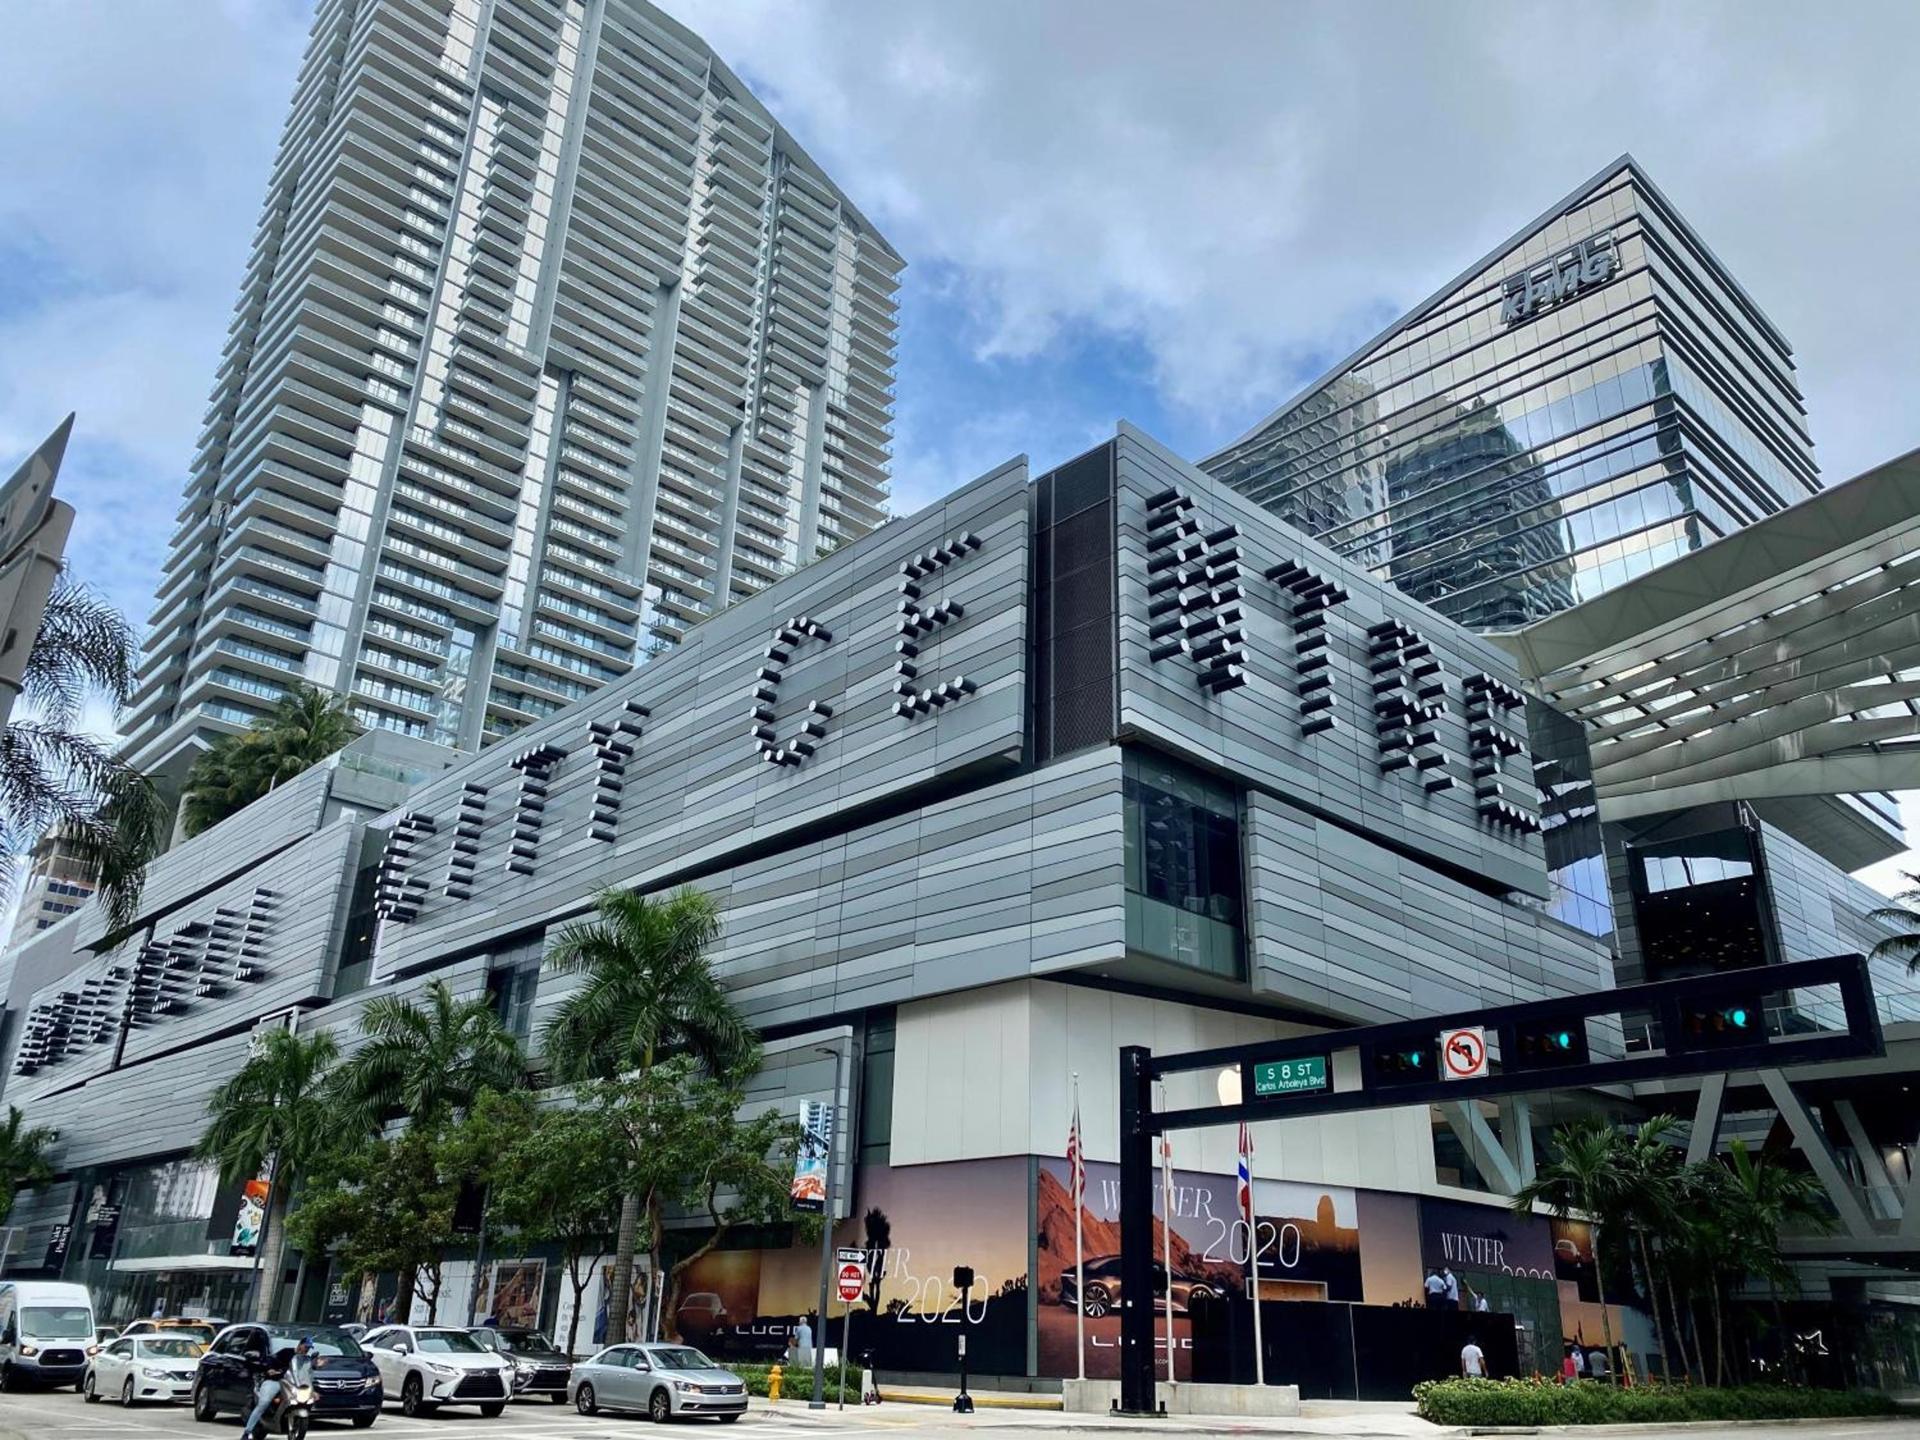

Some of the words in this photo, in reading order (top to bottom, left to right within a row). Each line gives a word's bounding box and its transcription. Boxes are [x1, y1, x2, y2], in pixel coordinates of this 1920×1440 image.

[1500, 252, 1617, 325] KPMG
[375, 700, 652, 924] CITY
[1257, 1082, 1276, 1092] Carlos
[1309, 1075, 1326, 1086] Blvd
[1268, 1068, 1275, 1079] S
[1282, 1065, 1291, 1078] 8
[1297, 1063, 1311, 1076] ST
[1202, 1217, 1300, 1268] 2020
[1441, 1232, 1506, 1268] WINTER
[841, 1287, 859, 1295] ENTER
[897, 1275, 989, 1324] 2020
